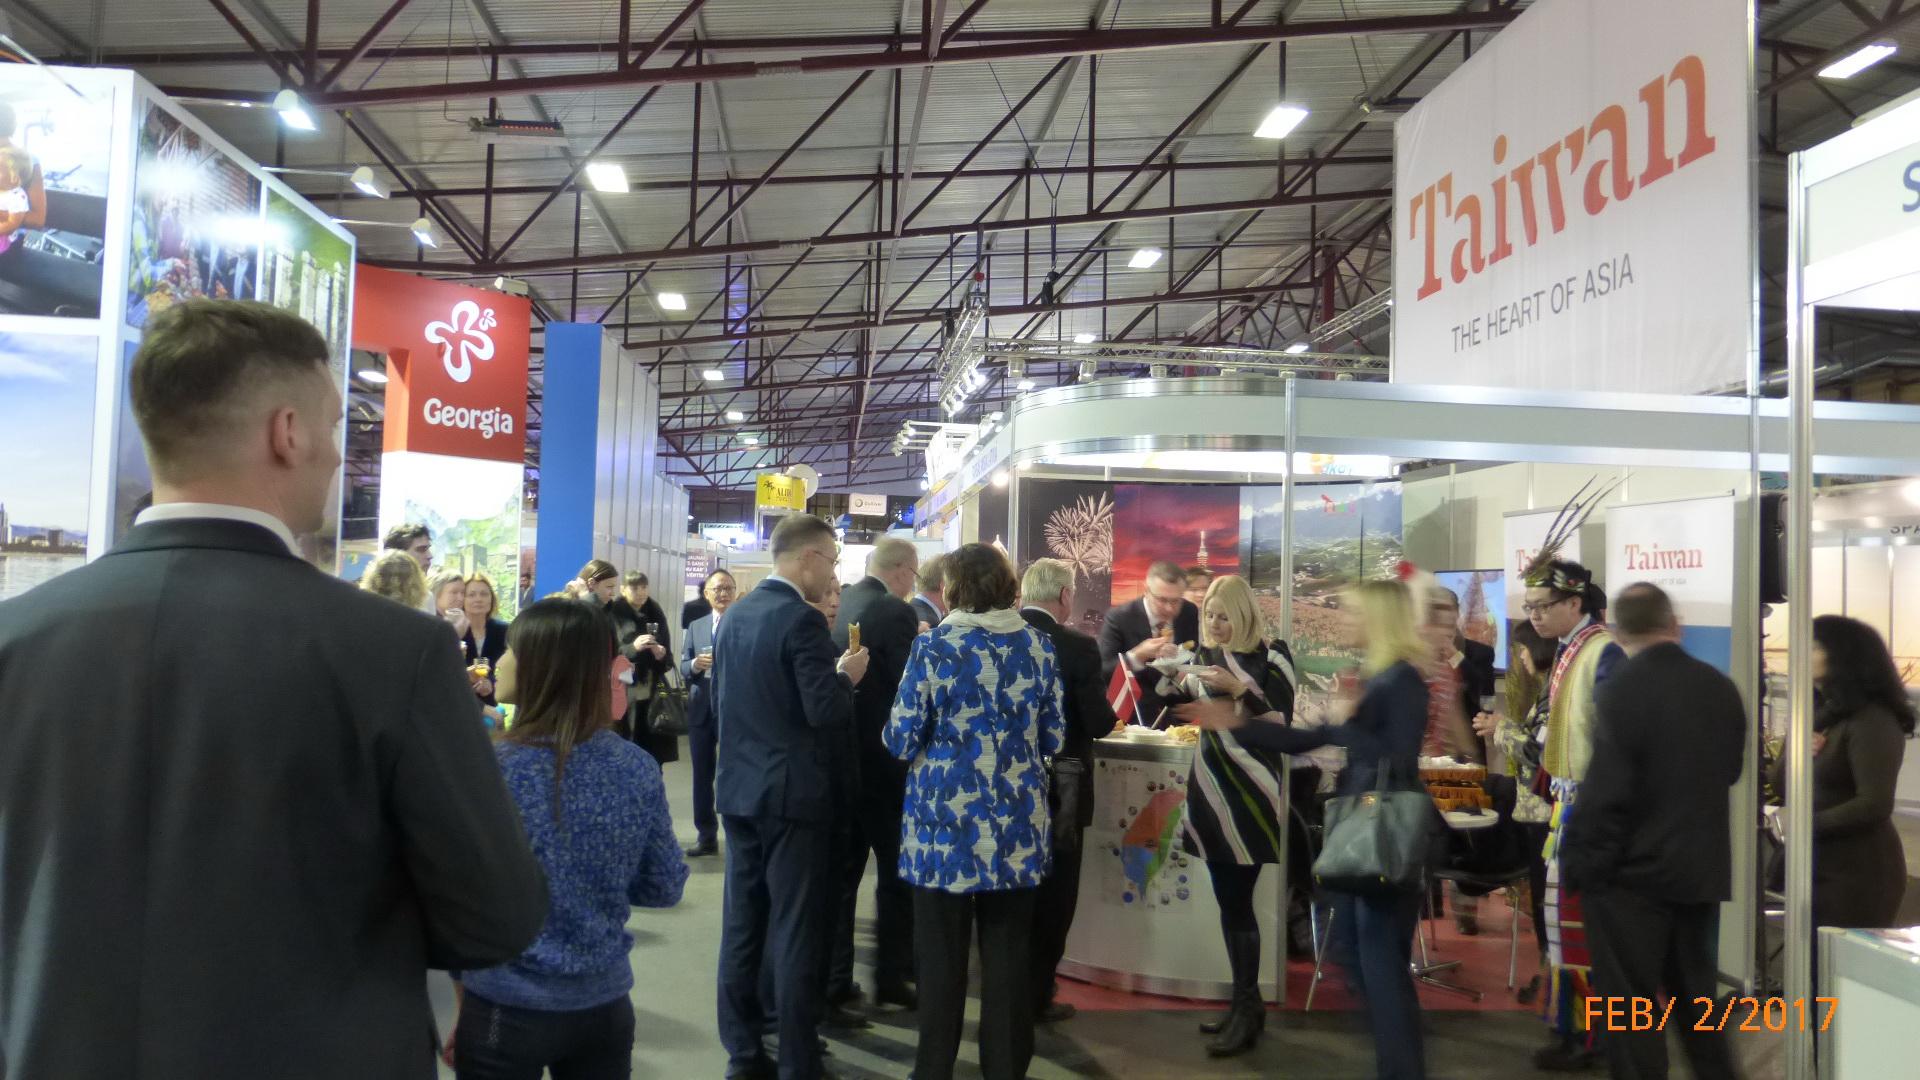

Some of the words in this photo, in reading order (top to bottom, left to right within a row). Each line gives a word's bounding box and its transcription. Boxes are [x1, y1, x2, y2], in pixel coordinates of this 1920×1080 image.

[1409, 53, 1716, 303] Taiwan
[1451, 317, 1481, 353] THE
[1486, 289, 1545, 341] HEART
[1550, 276, 1577, 315] OF
[1583, 252, 1634, 303] ASIA
[424, 397, 514, 440] Georgia
[1624, 543, 1703, 570] Taiwan
